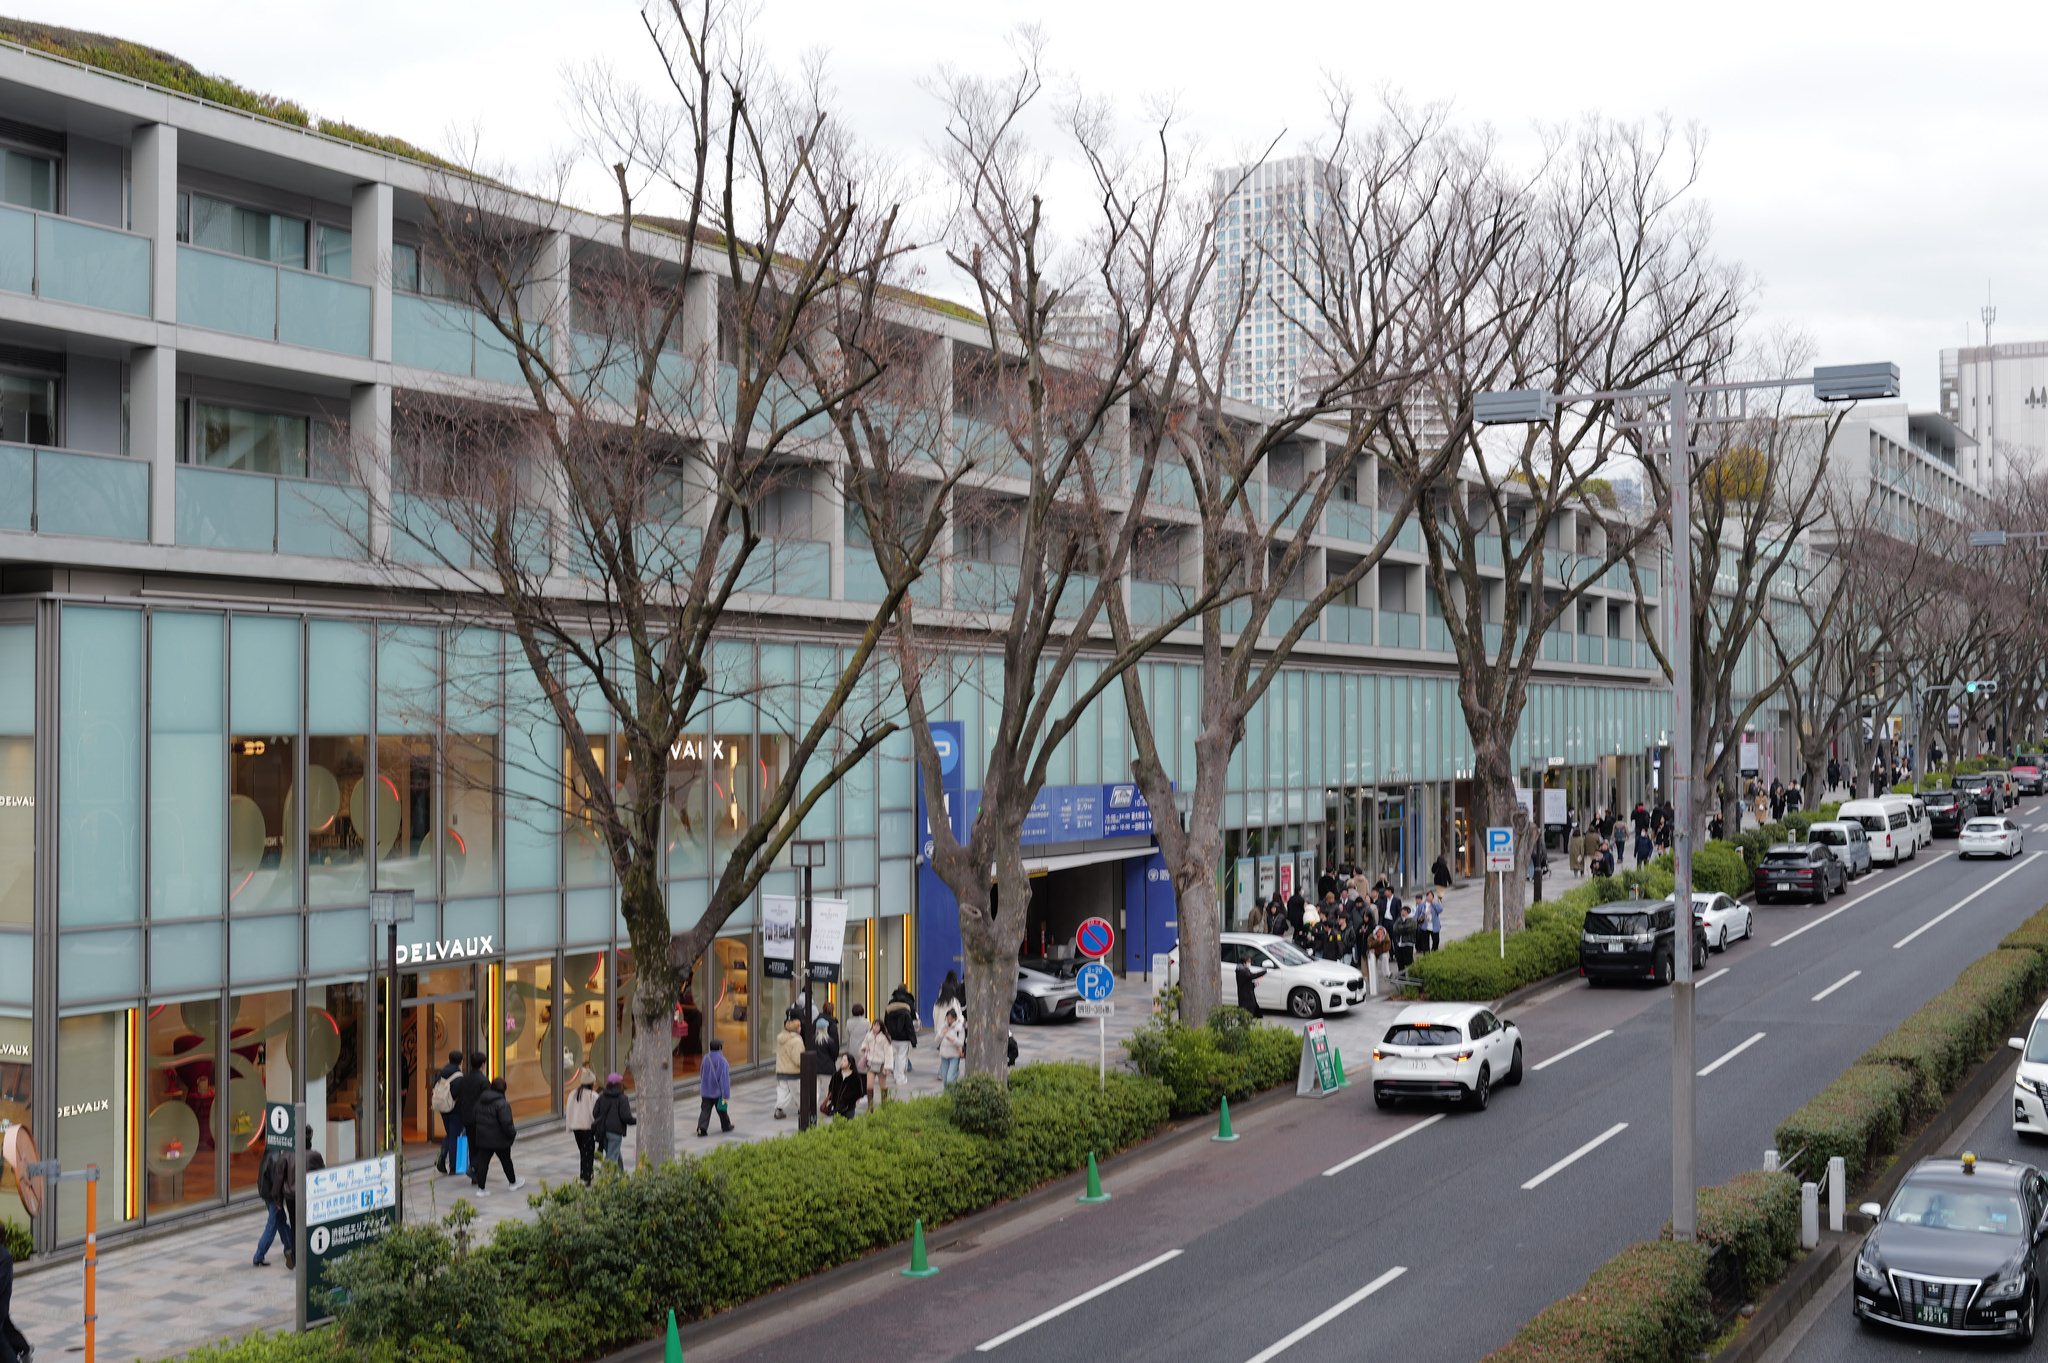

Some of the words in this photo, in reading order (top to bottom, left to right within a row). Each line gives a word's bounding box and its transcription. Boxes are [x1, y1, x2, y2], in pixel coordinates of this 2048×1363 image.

[0, 796, 35, 807] DELVAU
[1490, 831, 1511, 851] P
[396, 935, 494, 965] DELVAUX
[1084, 973, 1099, 998] P
